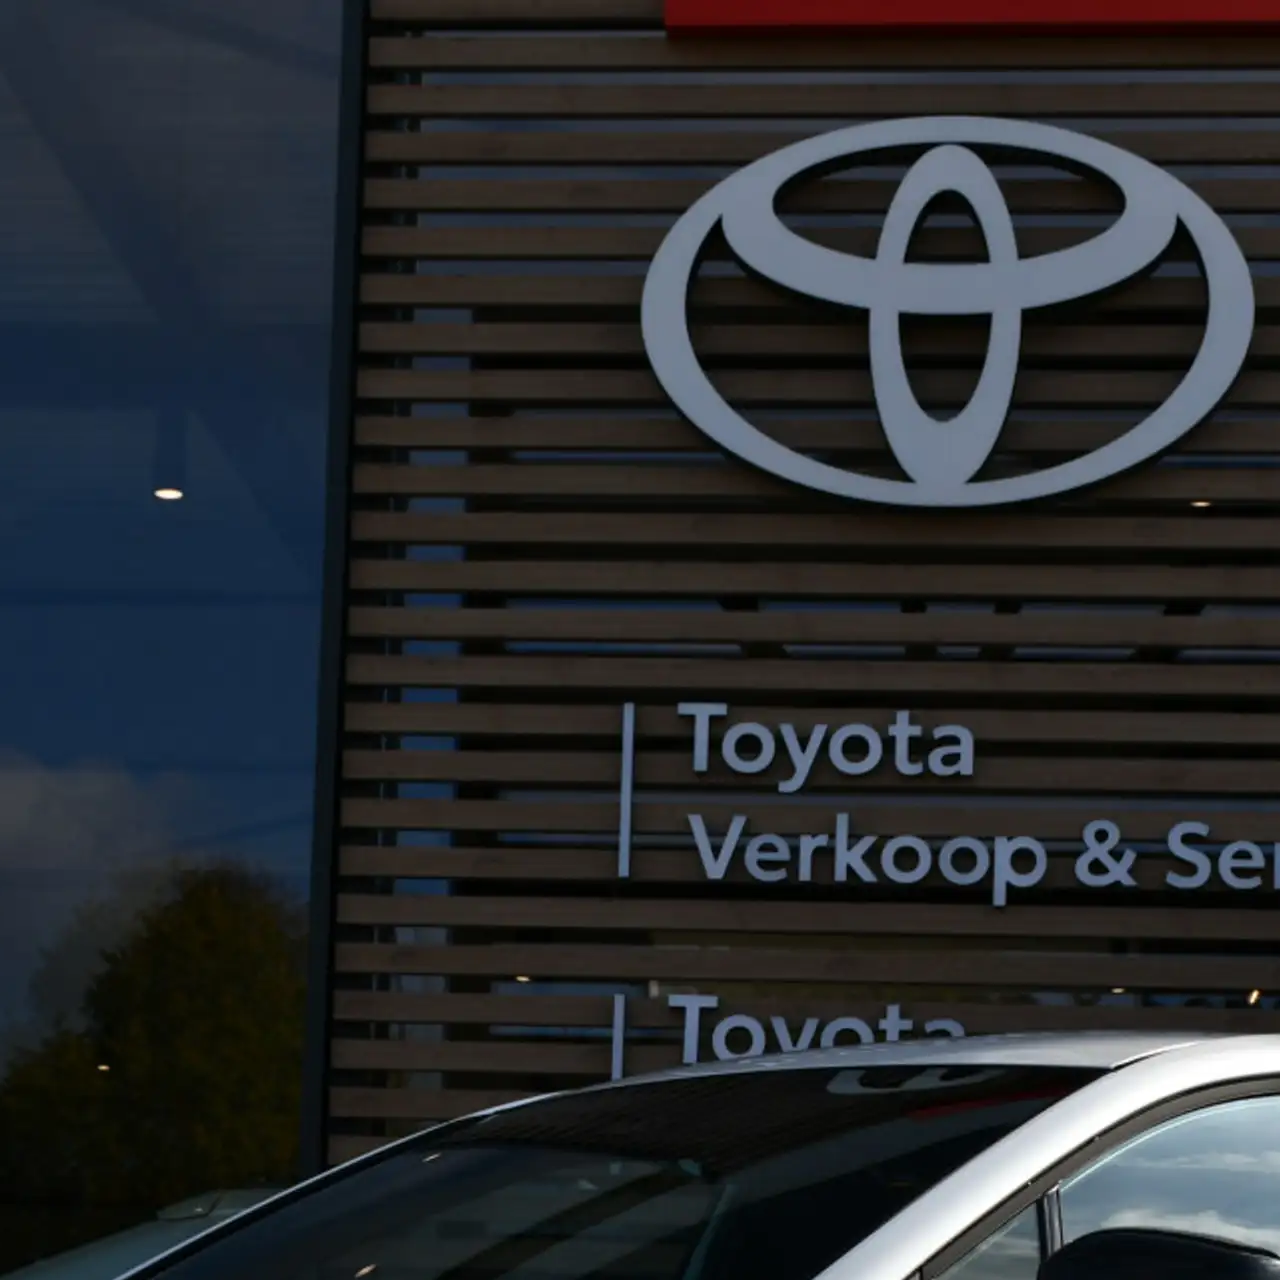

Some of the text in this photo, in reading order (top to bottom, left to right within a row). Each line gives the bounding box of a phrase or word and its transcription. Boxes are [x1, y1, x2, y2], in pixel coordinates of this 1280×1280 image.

[677, 703, 975, 792] Toyota
[687, 812, 1048, 906] Verkoop
[1074, 819, 1137, 888] &
